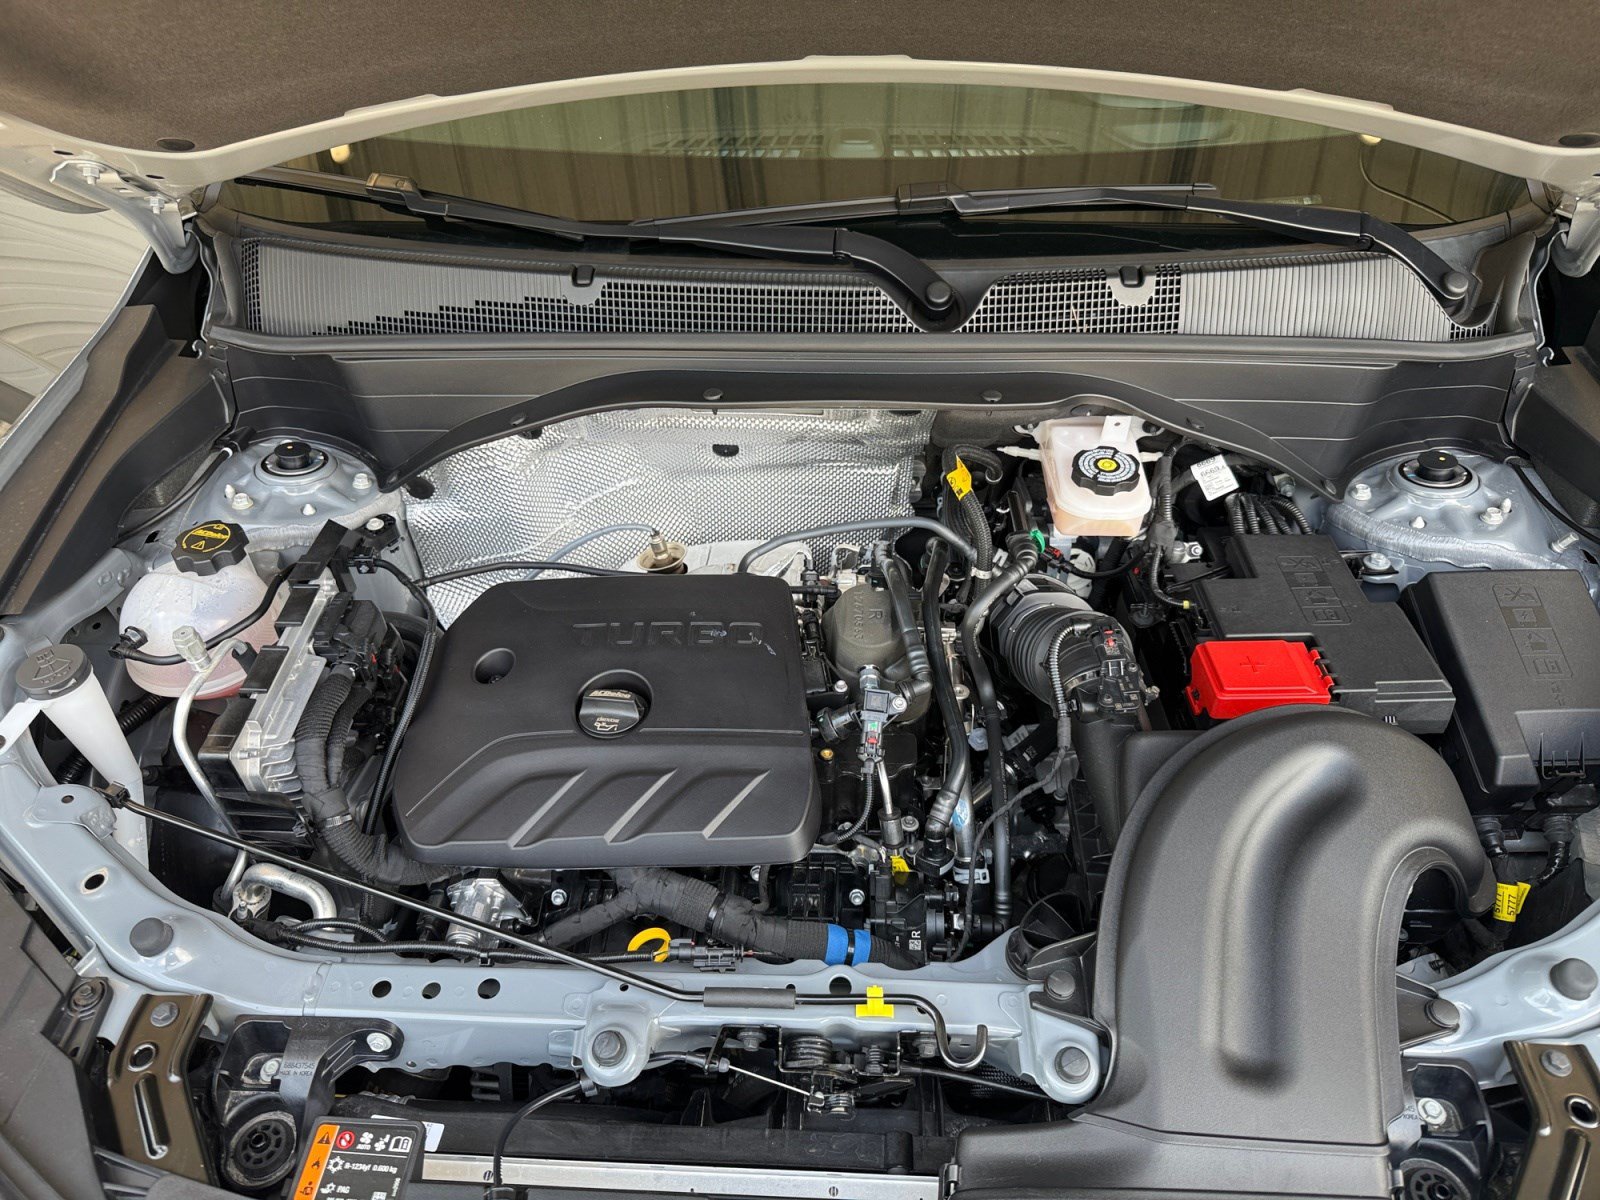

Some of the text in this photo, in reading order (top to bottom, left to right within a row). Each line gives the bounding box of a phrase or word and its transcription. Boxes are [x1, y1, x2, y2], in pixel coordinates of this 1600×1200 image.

[868, 608, 883, 619] R
[573, 621, 763, 646] TURBO
[589, 690, 631, 698] ACDelco
[1507, 893, 1517, 916] 5777
[911, 930, 921, 939] R
[389, 1166, 398, 1174] kg
